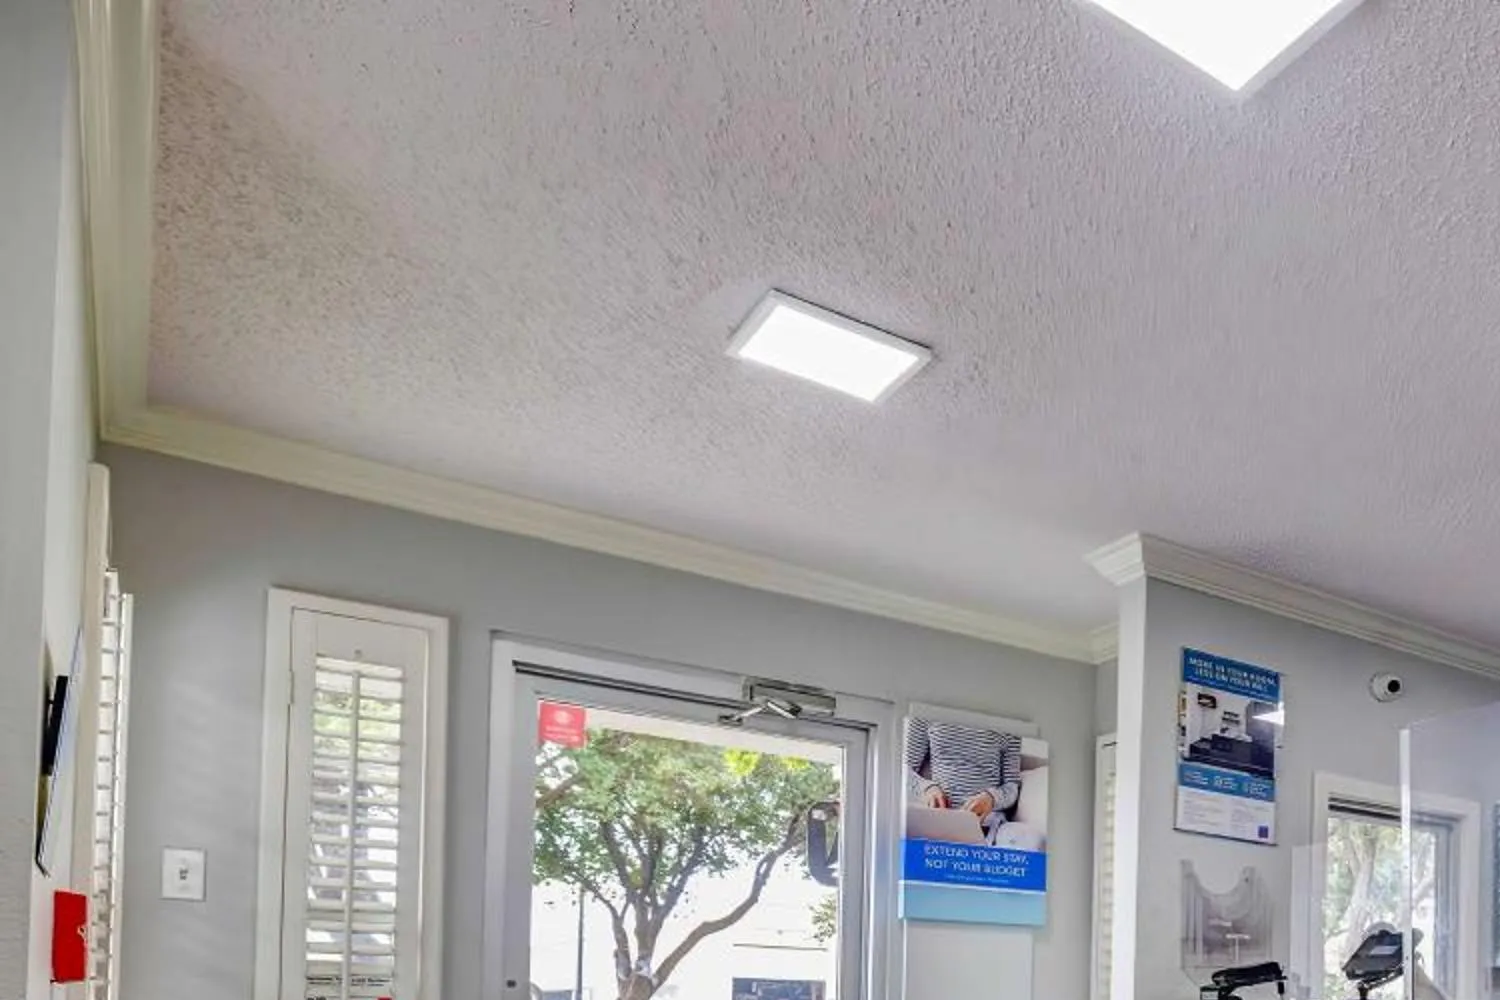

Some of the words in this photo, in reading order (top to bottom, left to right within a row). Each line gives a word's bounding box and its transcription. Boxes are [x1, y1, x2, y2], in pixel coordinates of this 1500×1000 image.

[924, 844, 969, 858] EXTEND
[971, 849, 1001, 861] YOUR
[925, 857, 948, 869] NOT
[951, 860, 981, 872] YOUR
[982, 864, 1026, 877] BUDGET
